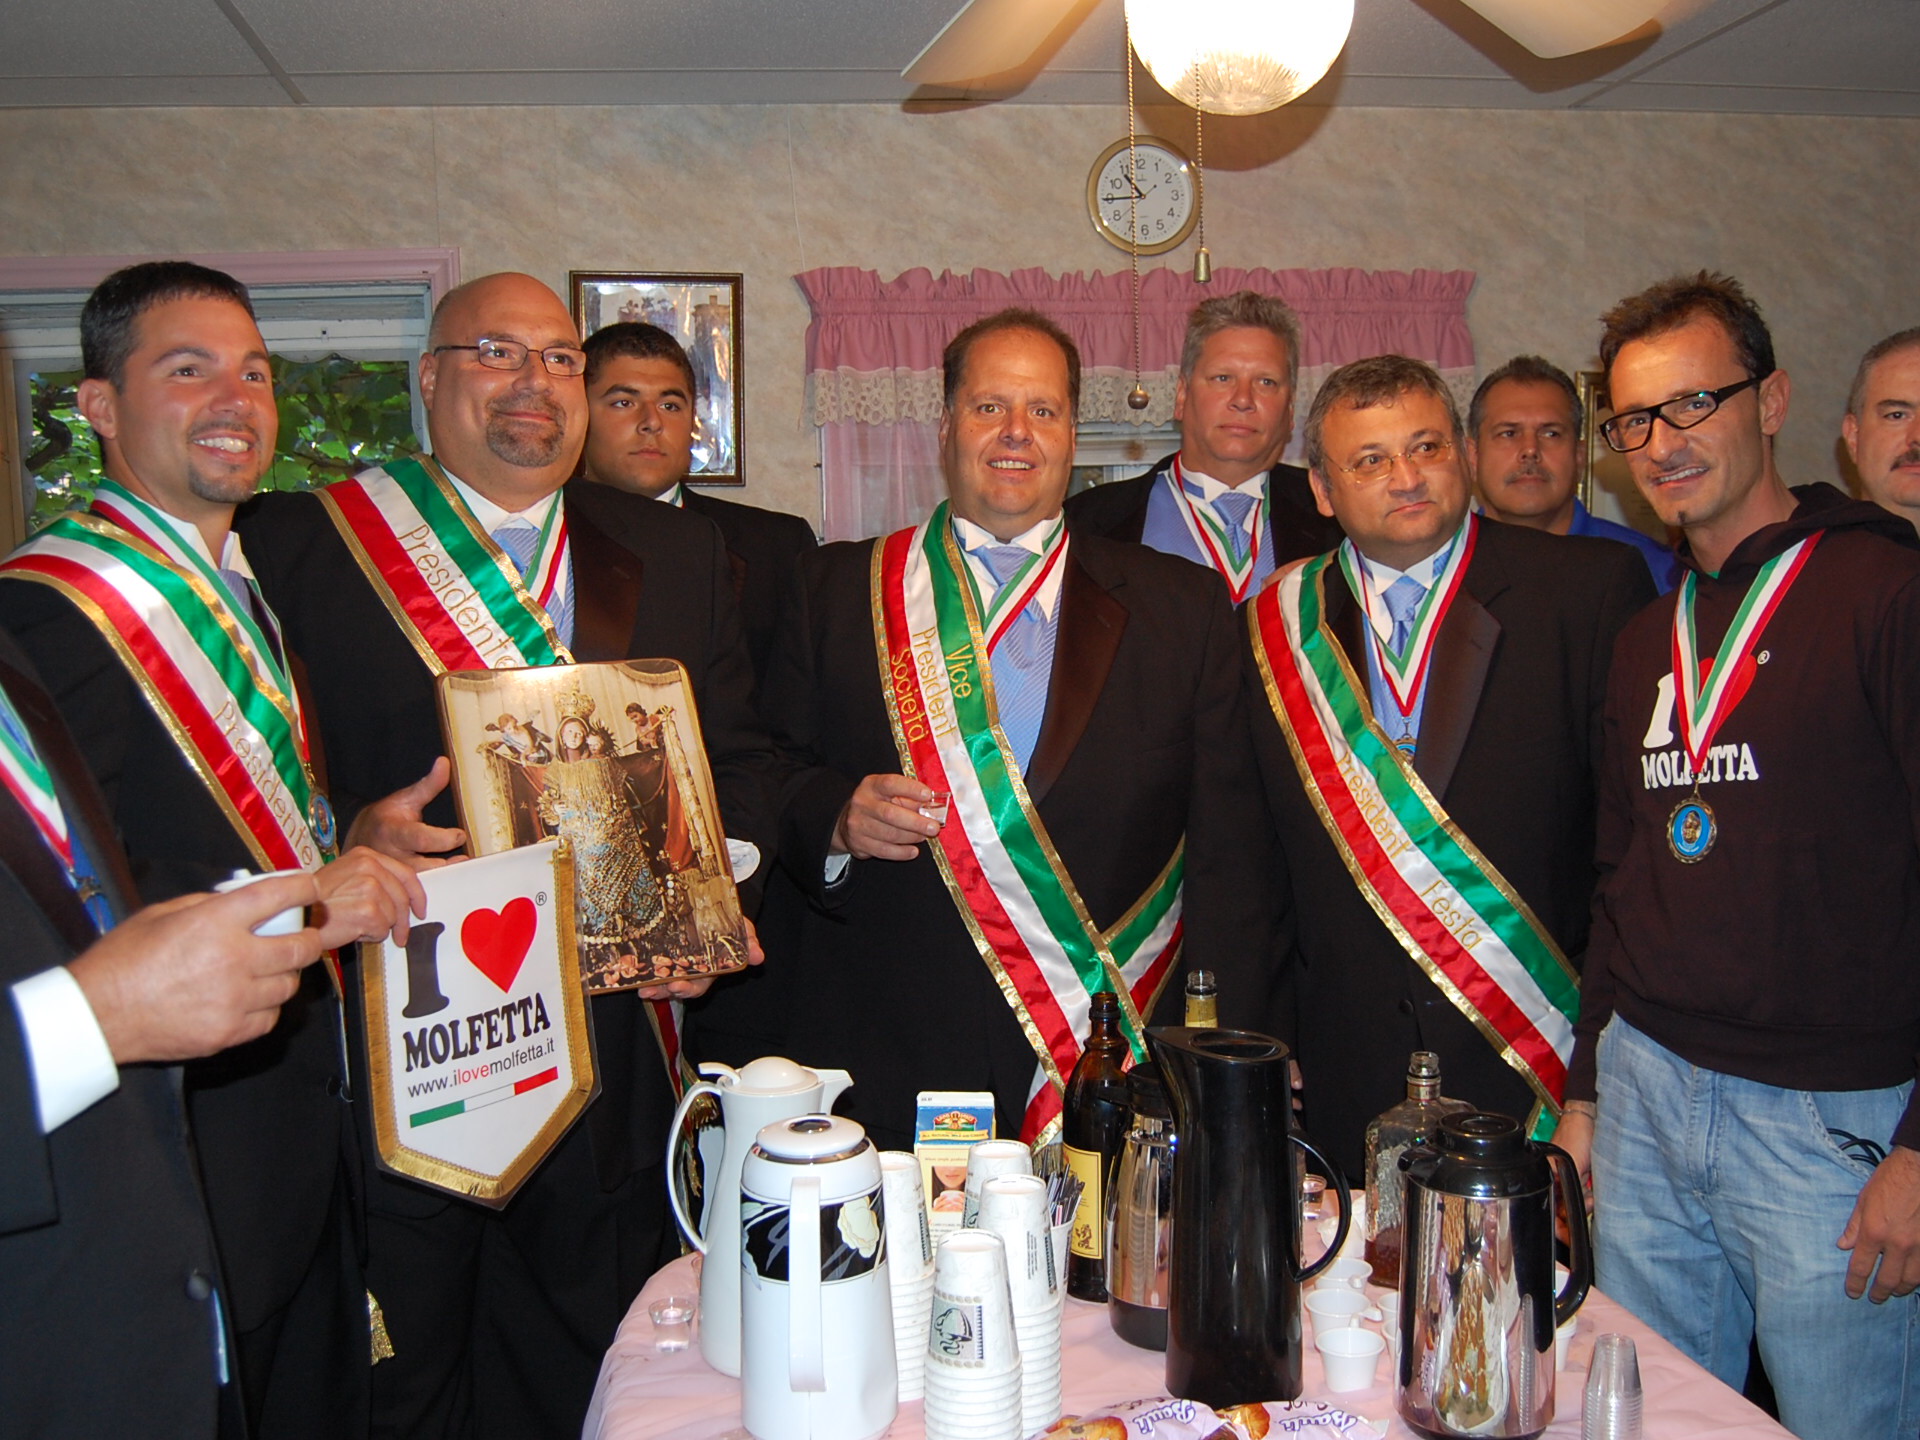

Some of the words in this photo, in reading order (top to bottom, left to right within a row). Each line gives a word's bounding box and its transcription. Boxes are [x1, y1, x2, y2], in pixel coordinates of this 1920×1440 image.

[1120, 164, 1130, 175] 11
[1135, 159, 1146, 169] 12
[1154, 162, 1160, 172] 1
[1164, 172, 1173, 183] 2
[1110, 178, 1123, 190] 10
[1106, 193, 1114, 204] 9
[1171, 190, 1180, 201] 3
[1113, 210, 1122, 221] 8
[1167, 207, 1175, 218] 4
[1127, 220, 1135, 232] 7
[1141, 224, 1150, 236] 6
[1156, 219, 1165, 230] 5
[396, 524, 518, 669] Presidente
[946, 644, 974, 699] Vice
[912, 626, 958, 738] President
[1643, 672, 1676, 748] I
[214, 701, 314, 865] Presidente
[1338, 751, 1411, 859] President
[1420, 880, 1483, 950] Festa
[402, 921, 450, 1019] I
[402, 992, 551, 1073] MOLFETTA
[407, 1037, 555, 1098] www.ilovemolfetta.it
[1132, 1399, 1196, 1435] Bauli
[1279, 1410, 1358, 1433] Bauli
